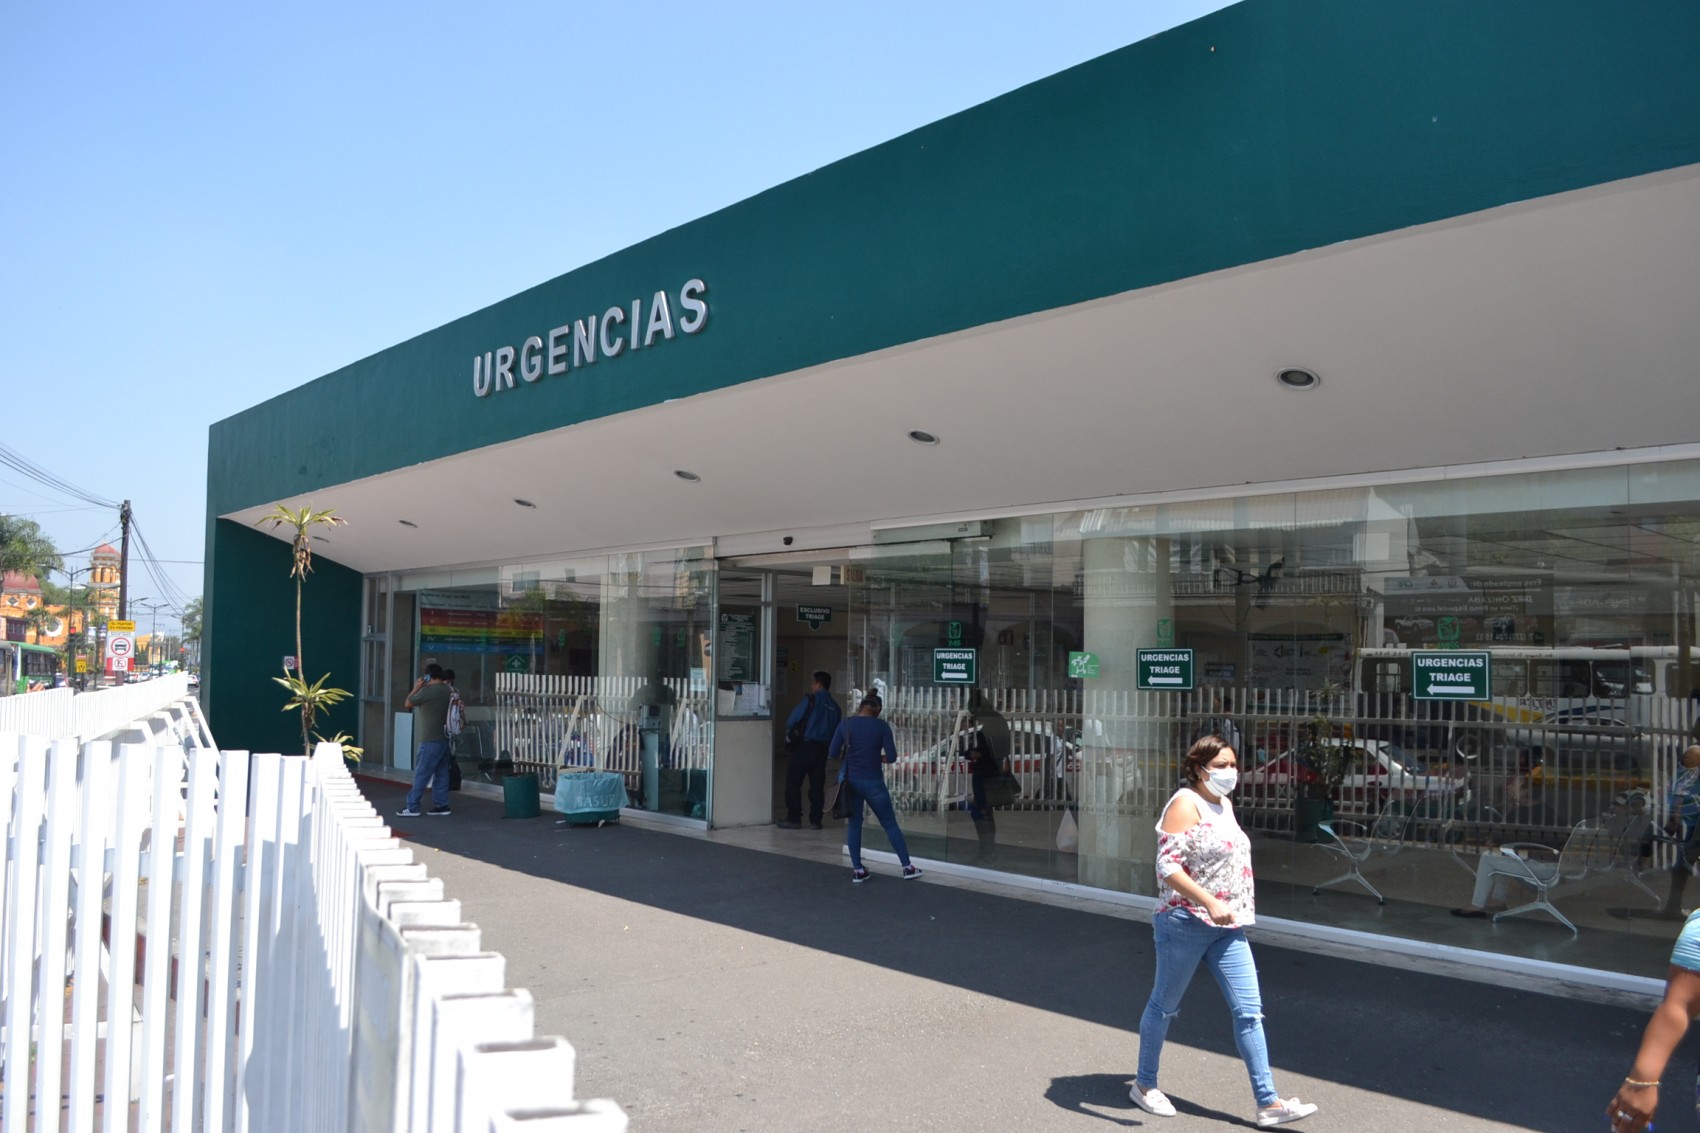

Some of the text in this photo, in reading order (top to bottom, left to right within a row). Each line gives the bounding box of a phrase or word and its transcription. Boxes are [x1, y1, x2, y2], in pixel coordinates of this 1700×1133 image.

[473, 278, 709, 397] URGENCIAS
[799, 606, 831, 615] EXCLUSIVO
[936, 652, 974, 660] URGENCIAS
[1140, 653, 1190, 662] URGENCIAS
[943, 662, 967, 670] TRIAGE
[1417, 658, 1485, 668] URGENCIAS
[1149, 666, 1181, 674] TRIAGE
[1429, 672, 1472, 683] TRIAGE
